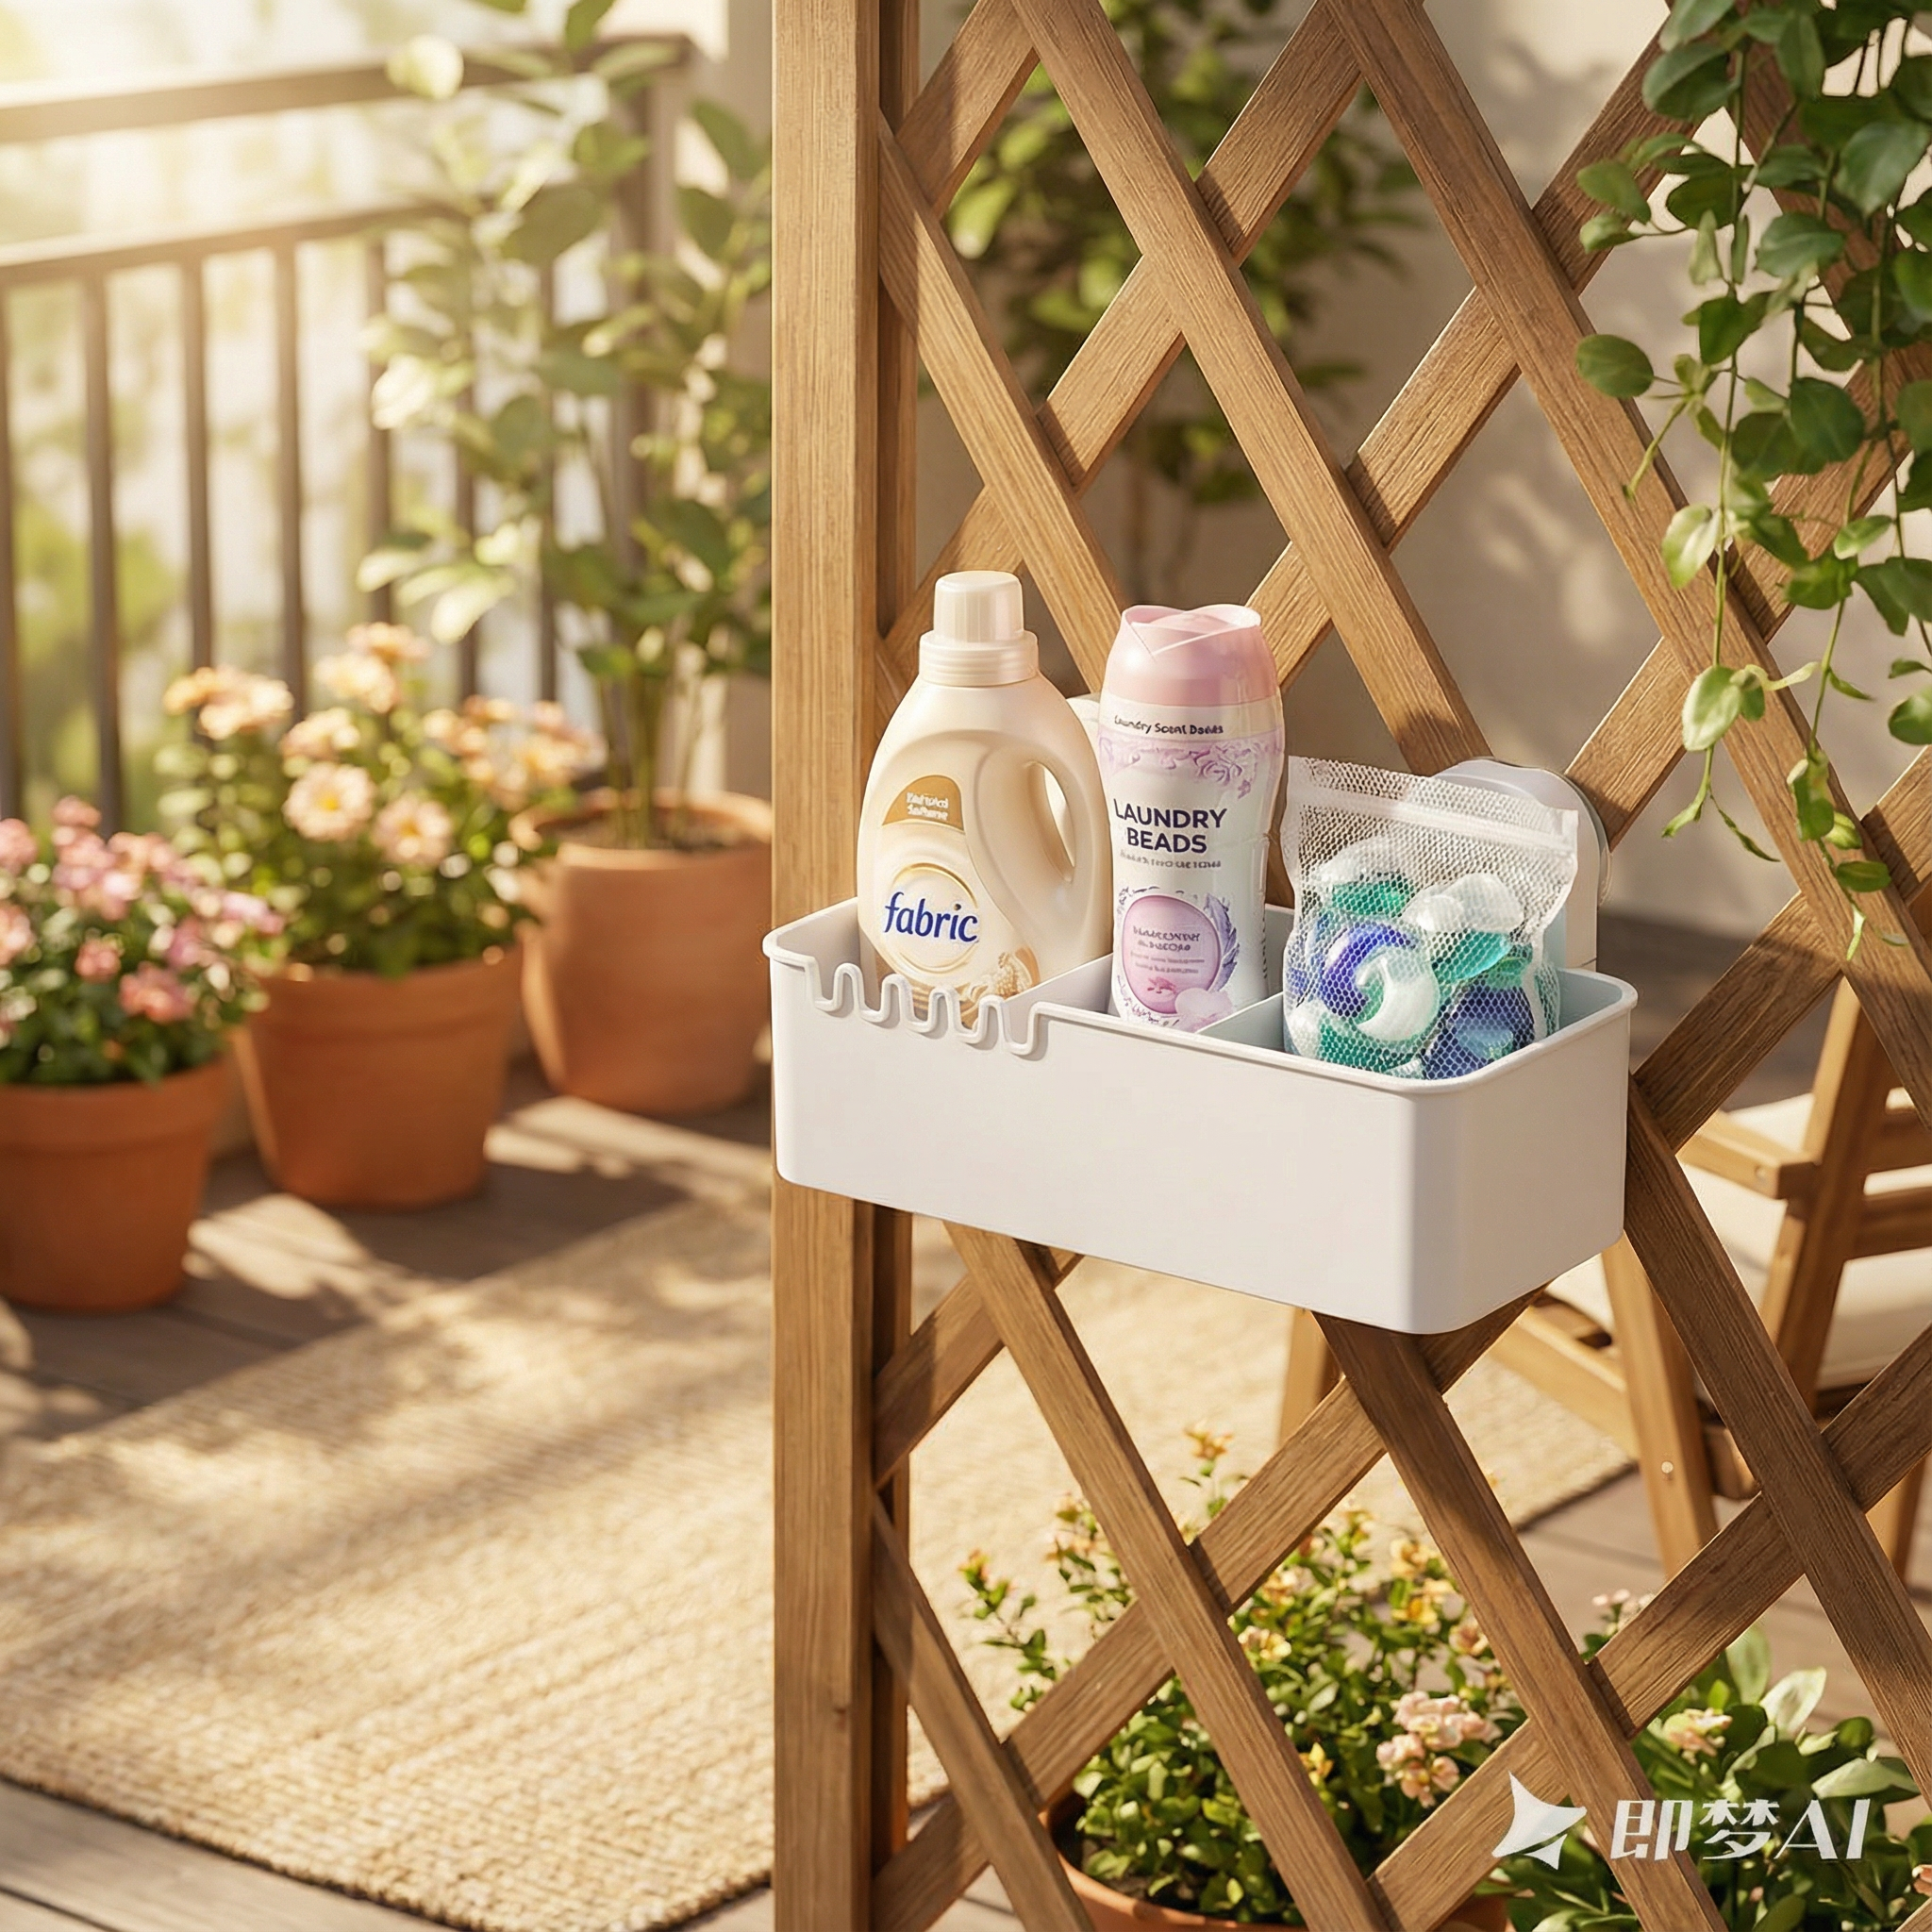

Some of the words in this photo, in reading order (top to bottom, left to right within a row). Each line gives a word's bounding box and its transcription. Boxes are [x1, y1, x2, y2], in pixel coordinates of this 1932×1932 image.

[1113, 798, 1227, 829] LAUNDRY
[1126, 826, 1208, 854] BEADS
[884, 891, 978, 942] fabric
